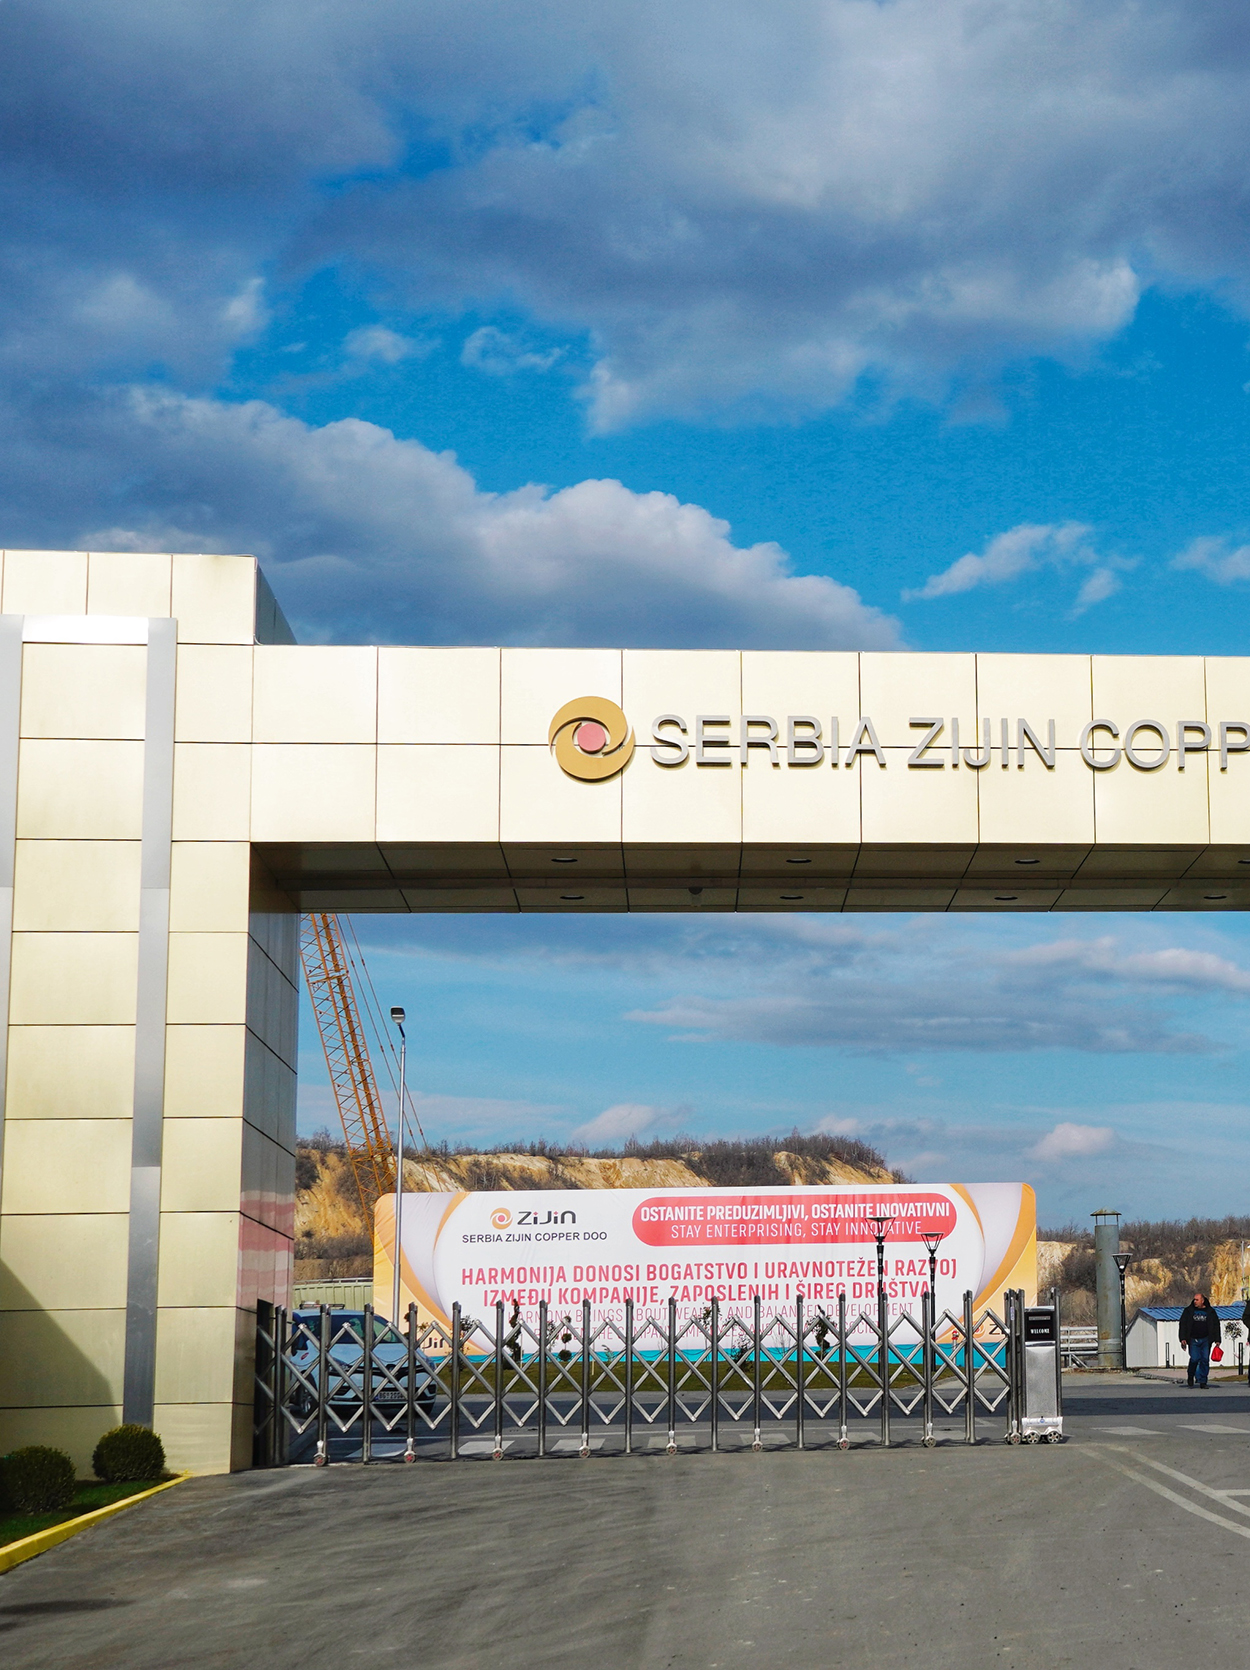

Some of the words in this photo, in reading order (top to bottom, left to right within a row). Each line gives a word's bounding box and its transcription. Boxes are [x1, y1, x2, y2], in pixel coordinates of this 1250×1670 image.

[650, 714, 886, 769] SERBIA
[908, 717, 1055, 769] ZIJIN
[640, 1205, 704, 1221] OSTANITE
[707, 1203, 809, 1222] PREDUZIMLJIVI,
[811, 1203, 873, 1218] OSTANITE
[876, 1202, 949, 1217] INOVATIVNI
[462, 1234, 503, 1244] SERBIA
[505, 1233, 532, 1243] ZIJIN
[535, 1232, 580, 1242] COPPER
[583, 1231, 608, 1241] DOO
[671, 1225, 701, 1238] STAY
[706, 1223, 806, 1238] ENTERPRISING,
[811, 1223, 840, 1236] STAY
[845, 1221, 922, 1236] INNOVATIVE
[462, 1266, 567, 1286] HARMONIJA
[573, 1264, 640, 1282] DONOSI
[647, 1262, 748, 1281] BOGATSTVO
[754, 1262, 758, 1279] I
[484, 1288, 551, 1307] IZMEĐU
[558, 1286, 665, 1307] KOMPANIJE,
[670, 1284, 778, 1302] ZAPOSLENIH
[785, 1283, 789, 1300] I
[796, 1280, 845, 1300] ŠIREG
[576, 1309, 623, 1322] BINGS
[631, 1307, 667, 1321] BOUT
